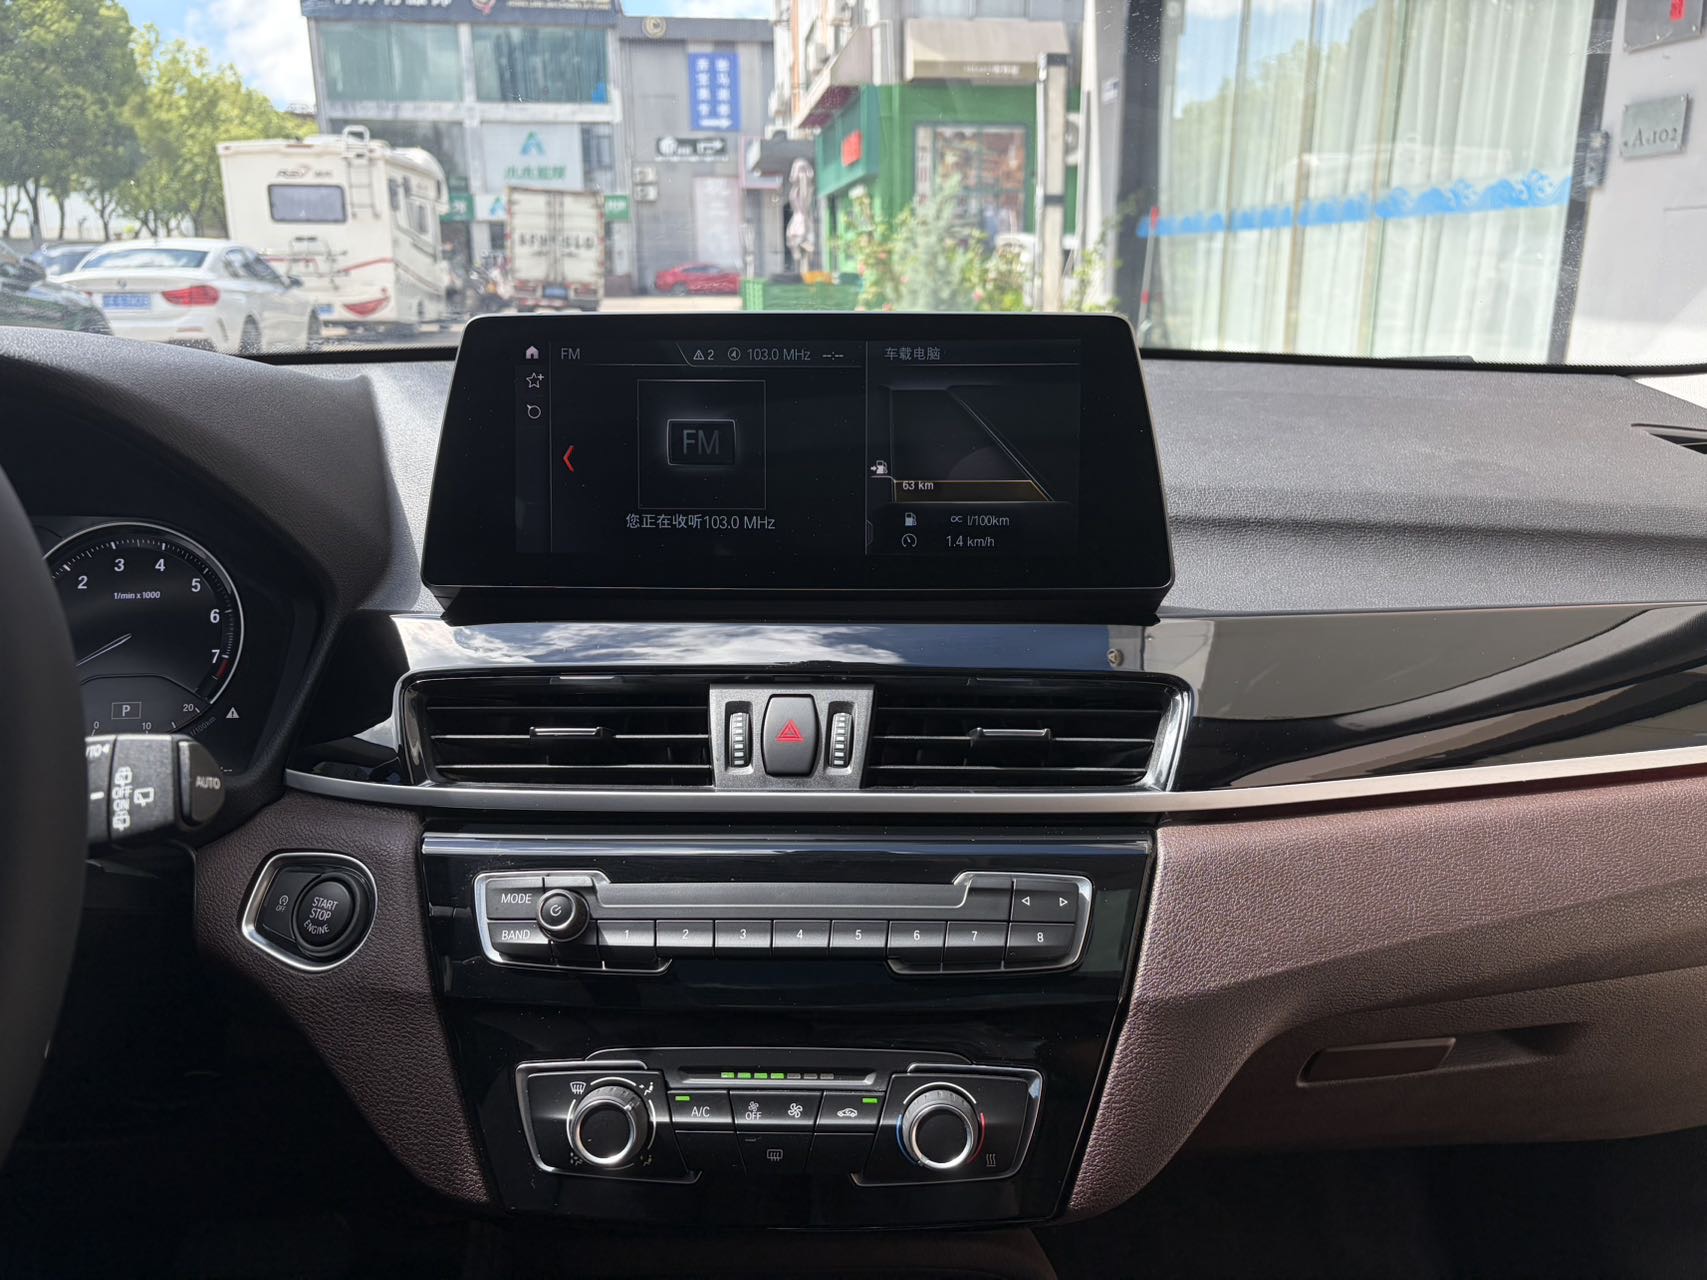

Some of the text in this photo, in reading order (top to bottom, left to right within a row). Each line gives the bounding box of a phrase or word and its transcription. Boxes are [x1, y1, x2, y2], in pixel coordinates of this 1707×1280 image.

[560, 348, 581, 360] FM
[707, 349, 715, 361] 2
[747, 348, 811, 361] 103.0 MHz
[884, 346, 941, 361] 车载电脑
[682, 428, 720, 455] FM
[902, 480, 934, 491] 63 km
[744, 515, 776, 530] MHz
[946, 535, 995, 548] 1.4 km/h
[114, 558, 125, 572] 3
[155, 558, 166, 572] 4
[77, 575, 88, 589] 2
[191, 578, 201, 592] 5
[113, 592, 135, 600] 1/min
[142, 591, 161, 599] 1000
[210, 609, 220, 623] 6
[211, 649, 220, 663] 7
[122, 705, 131, 717] P
[183, 703, 194, 712] 20
[93, 721, 100, 730] 0
[142, 722, 152, 730] 10
[195, 776, 221, 789] AUTO
[112, 786, 132, 799] OFF
[113, 799, 130, 811] ON
[312, 896, 339, 911] START
[501, 893, 532, 904] MODE
[275, 904, 287, 912] OFF
[309, 907, 332, 921] STOP
[303, 919, 330, 935] ENGINE
[502, 930, 531, 941] BAND
[682, 929, 689, 940] 2
[739, 929, 747, 940] 3
[796, 929, 804, 940] 4
[855, 930, 862, 941] 5
[913, 930, 920, 941] 6
[971, 931, 978, 942] 7
[1037, 932, 1044, 943] 8
[691, 1106, 710, 1118] A/C
[745, 1111, 762, 1120] OFF
